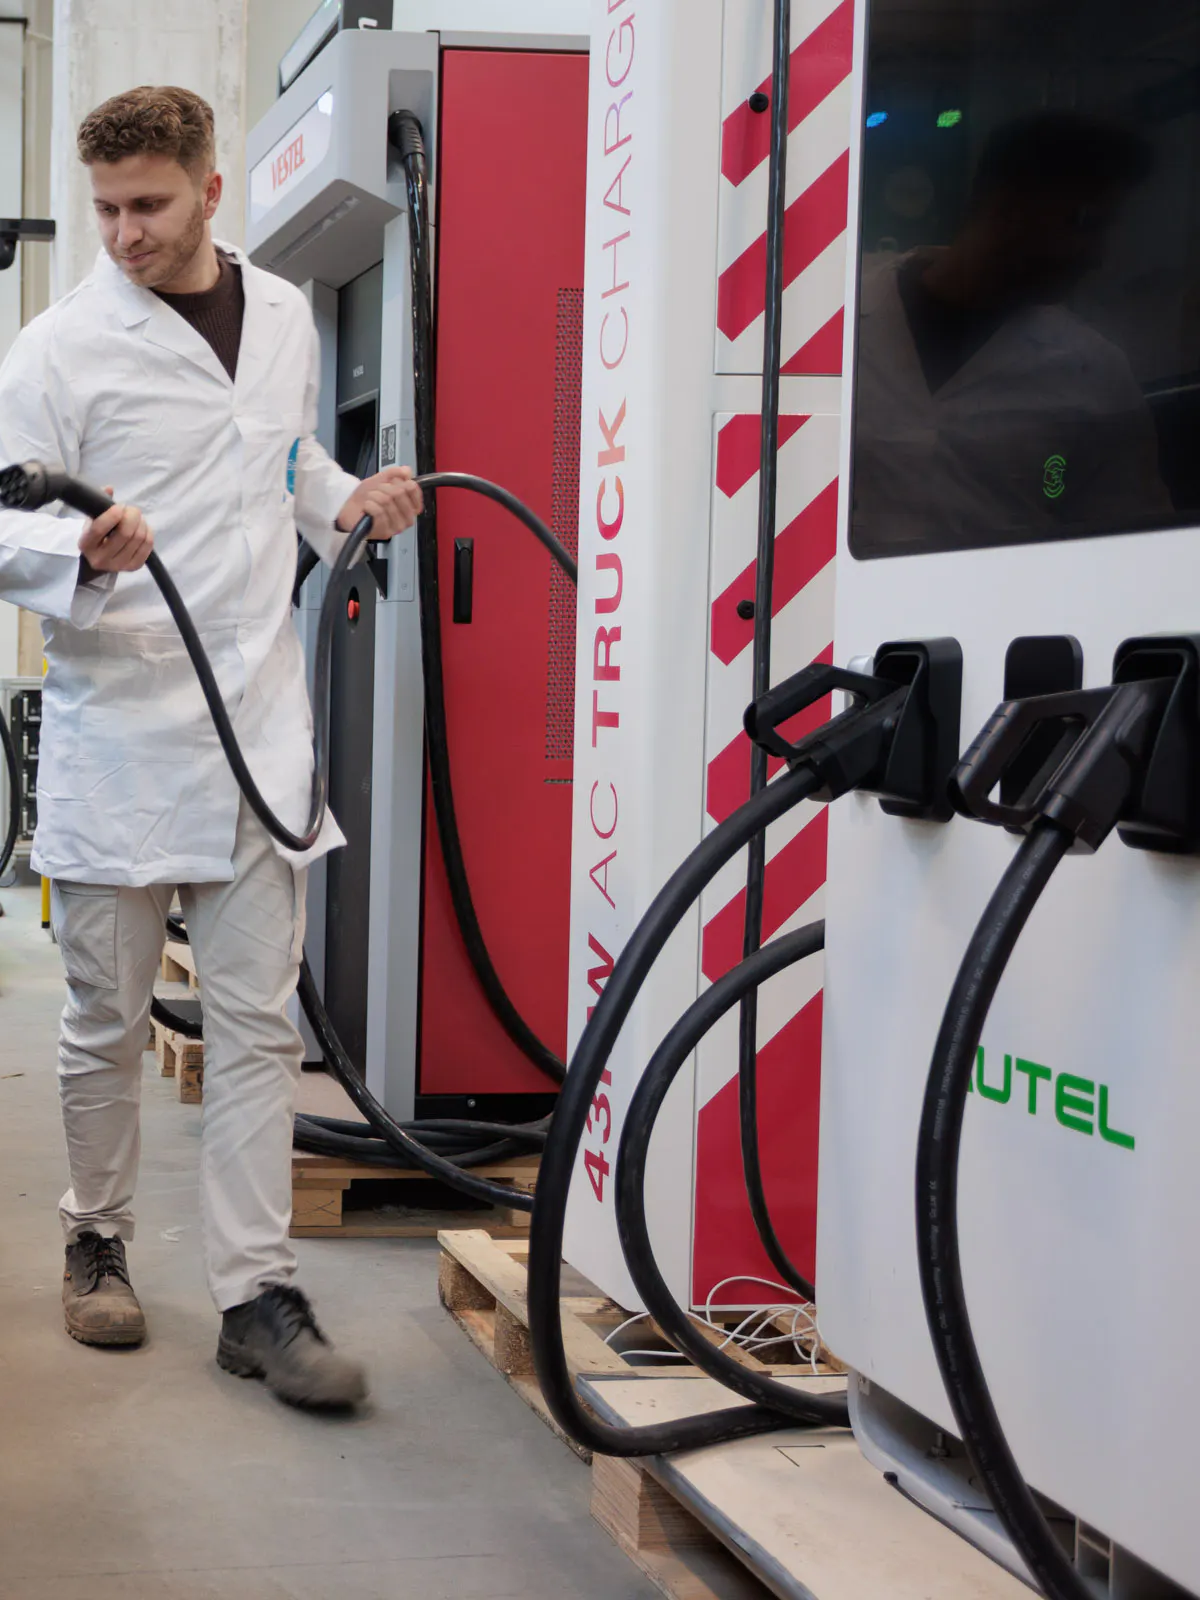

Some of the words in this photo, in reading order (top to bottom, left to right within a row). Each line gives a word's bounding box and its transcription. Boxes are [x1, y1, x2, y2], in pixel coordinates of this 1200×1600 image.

[270, 133, 306, 192] VESTEL
[591, 397, 627, 749] TRUCK
[589, 780, 618, 910] AC
[584, 932, 615, 1203] 43W
[964, 1044, 1135, 1151] UTEL
